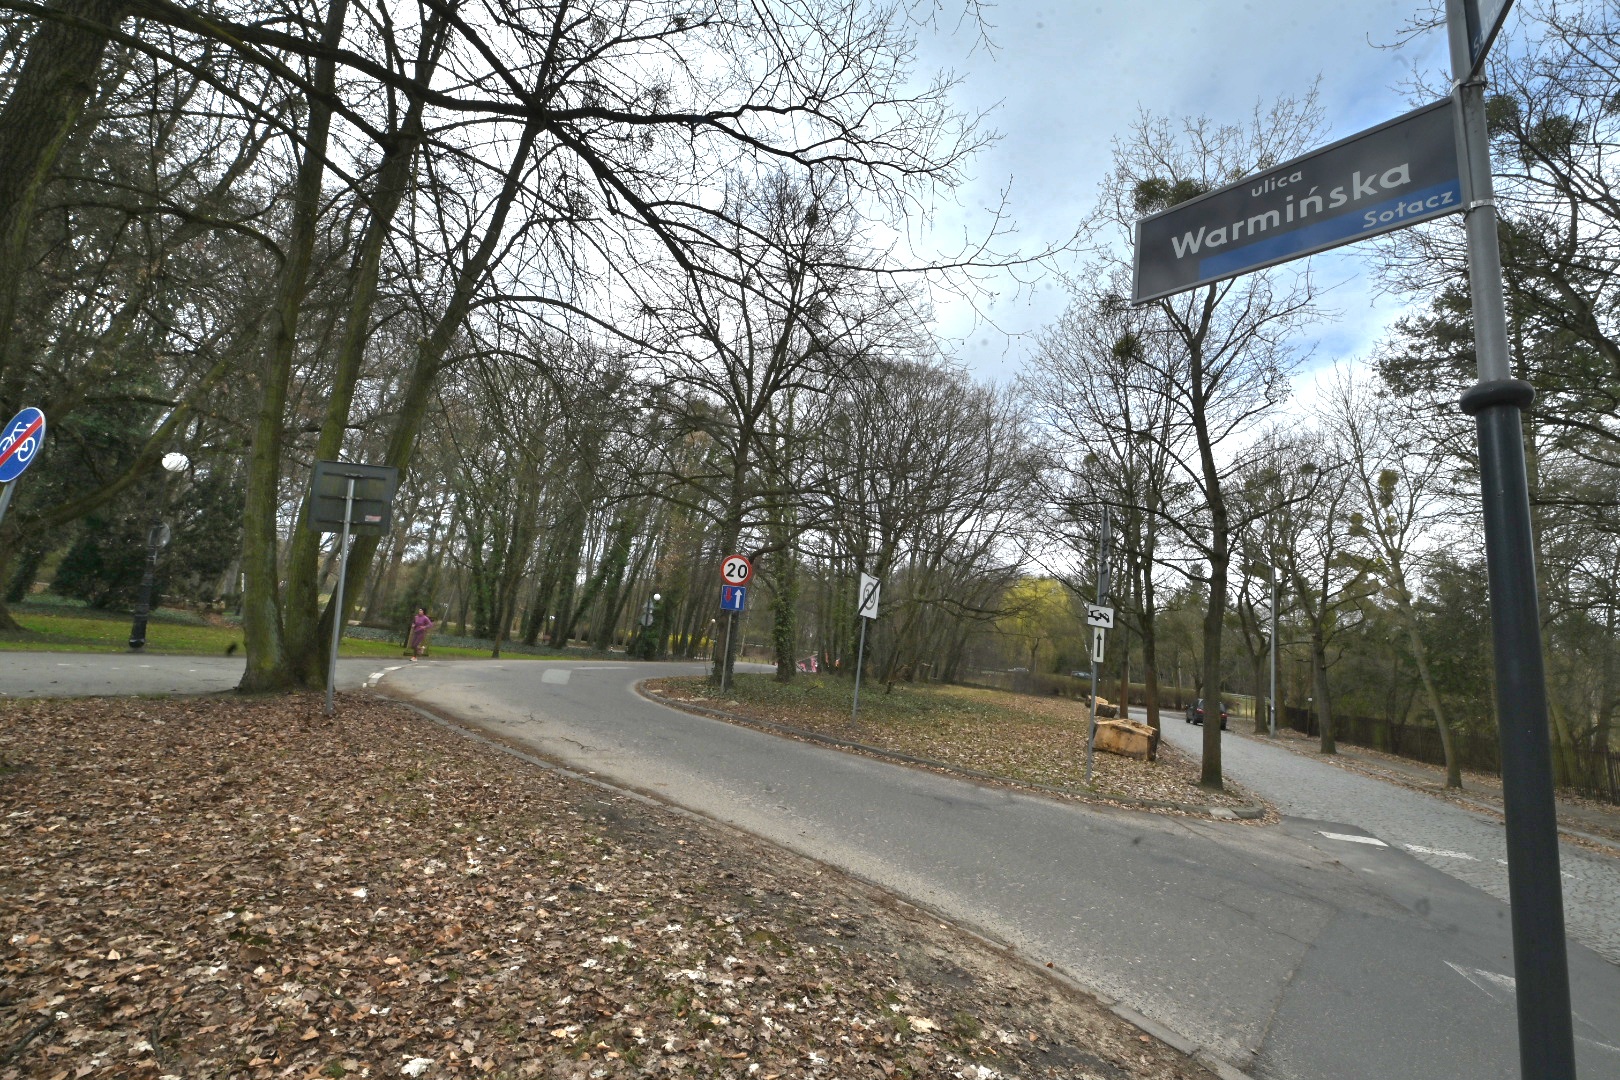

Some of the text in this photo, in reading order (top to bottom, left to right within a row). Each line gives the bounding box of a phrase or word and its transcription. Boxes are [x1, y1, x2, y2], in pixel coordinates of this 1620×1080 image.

[1251, 171, 1303, 198] ulica
[1171, 162, 1412, 259] Warmińska
[1362, 190, 1454, 229] Sołacz
[725, 562, 748, 579] 20
